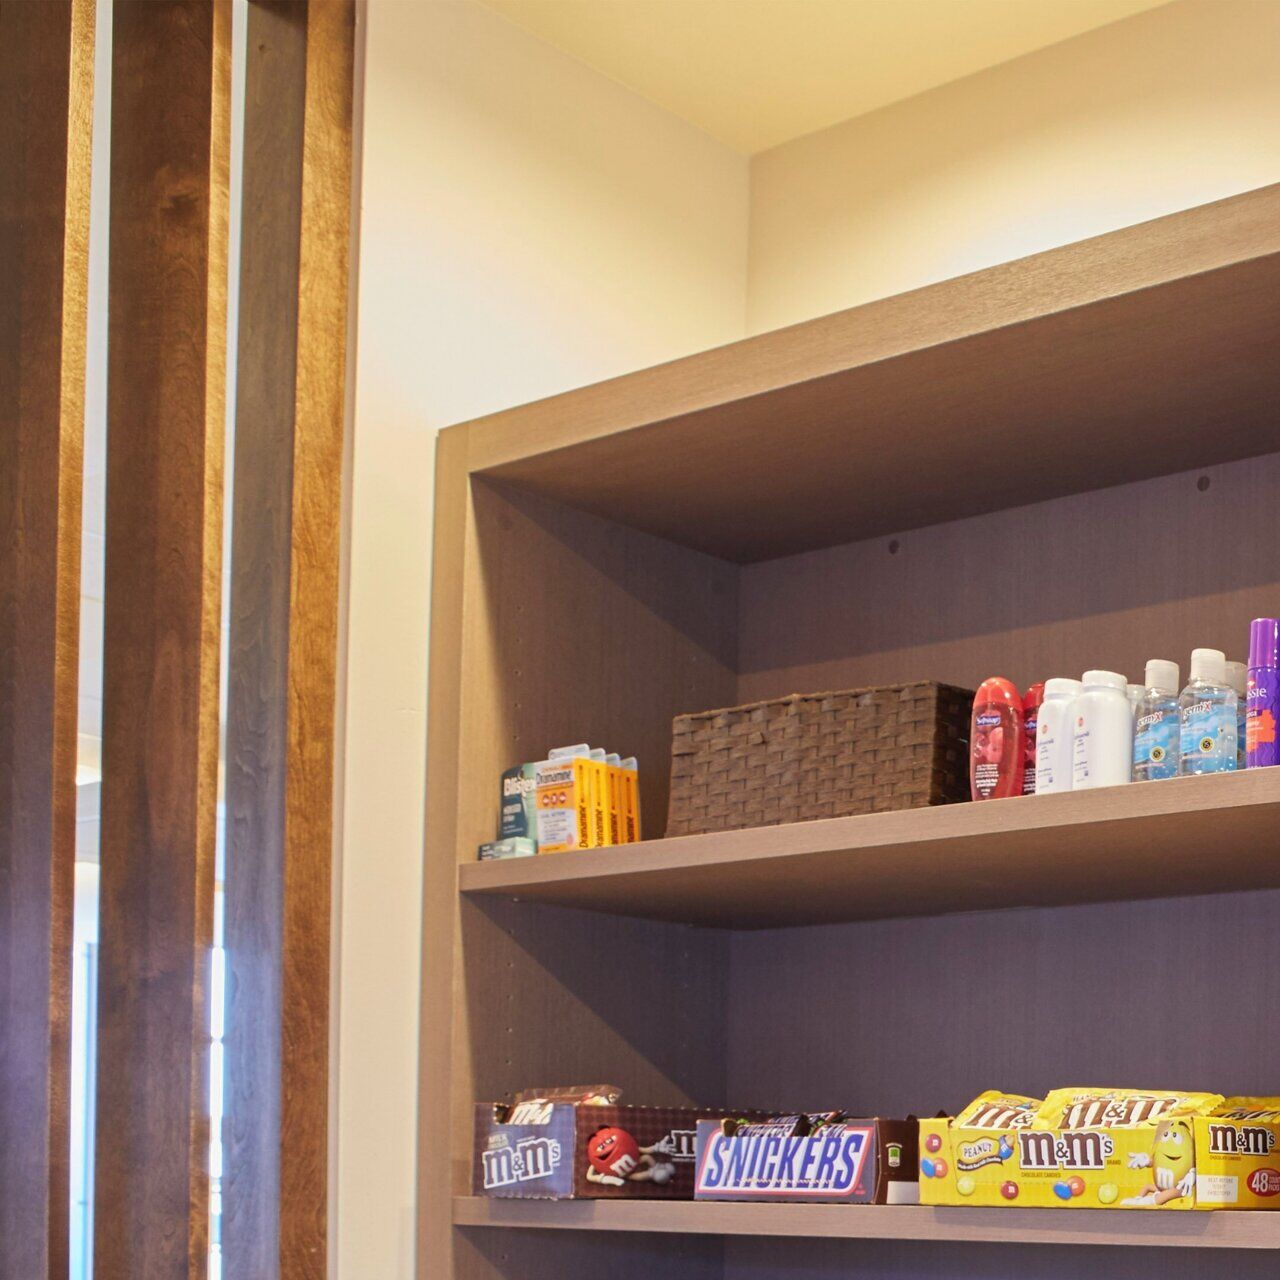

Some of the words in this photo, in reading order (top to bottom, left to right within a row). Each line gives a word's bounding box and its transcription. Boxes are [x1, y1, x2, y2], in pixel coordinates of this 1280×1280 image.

[1247, 687, 1267, 699] ssie
[964, 1142, 992, 1158] PEANUT
[1019, 1132, 1114, 1169] m&m's
[1209, 1124, 1275, 1155] m&m's
[482, 1138, 561, 1189] m&m's
[704, 1135, 864, 1189] SNICKERS
[1252, 1172, 1268, 1192] 48
